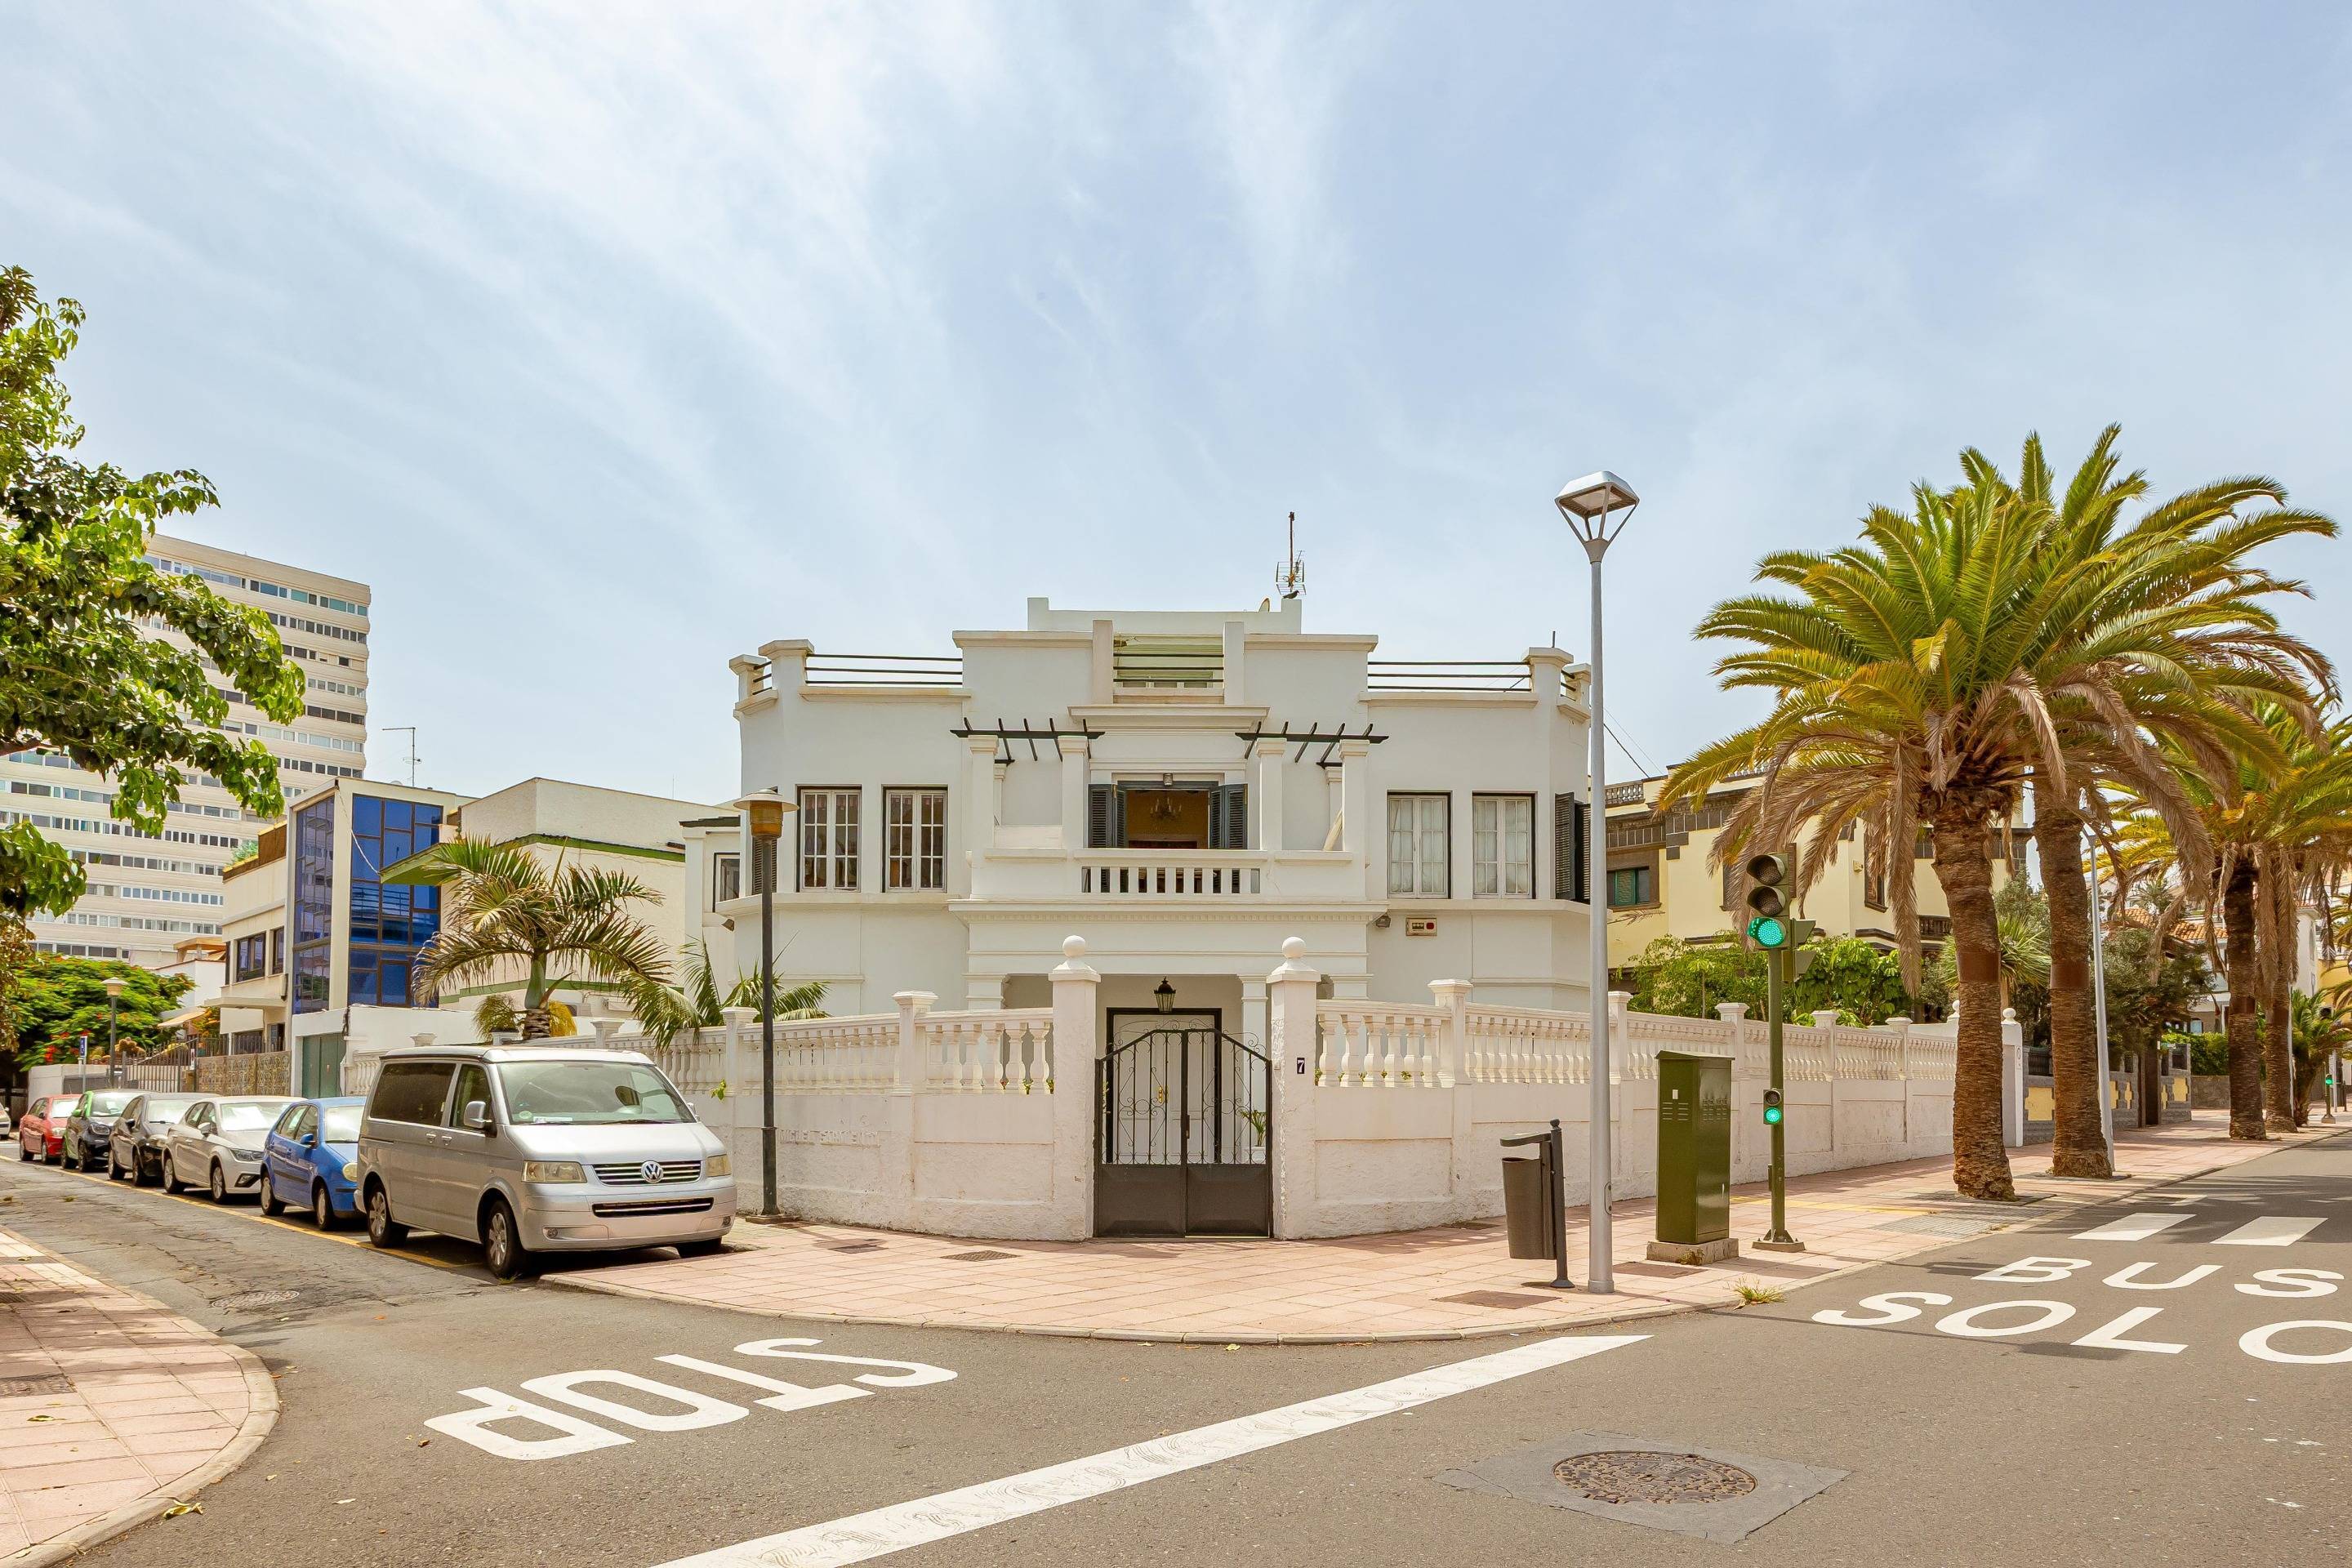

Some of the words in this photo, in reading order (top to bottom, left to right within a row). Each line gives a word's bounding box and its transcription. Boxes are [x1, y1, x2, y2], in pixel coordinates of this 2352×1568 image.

[1297, 1059, 1305, 1073] 7
[1971, 1256, 2345, 1298] BUS
[1811, 1291, 2352, 1365] SOLO
[423, 1337, 959, 1461] STOP
